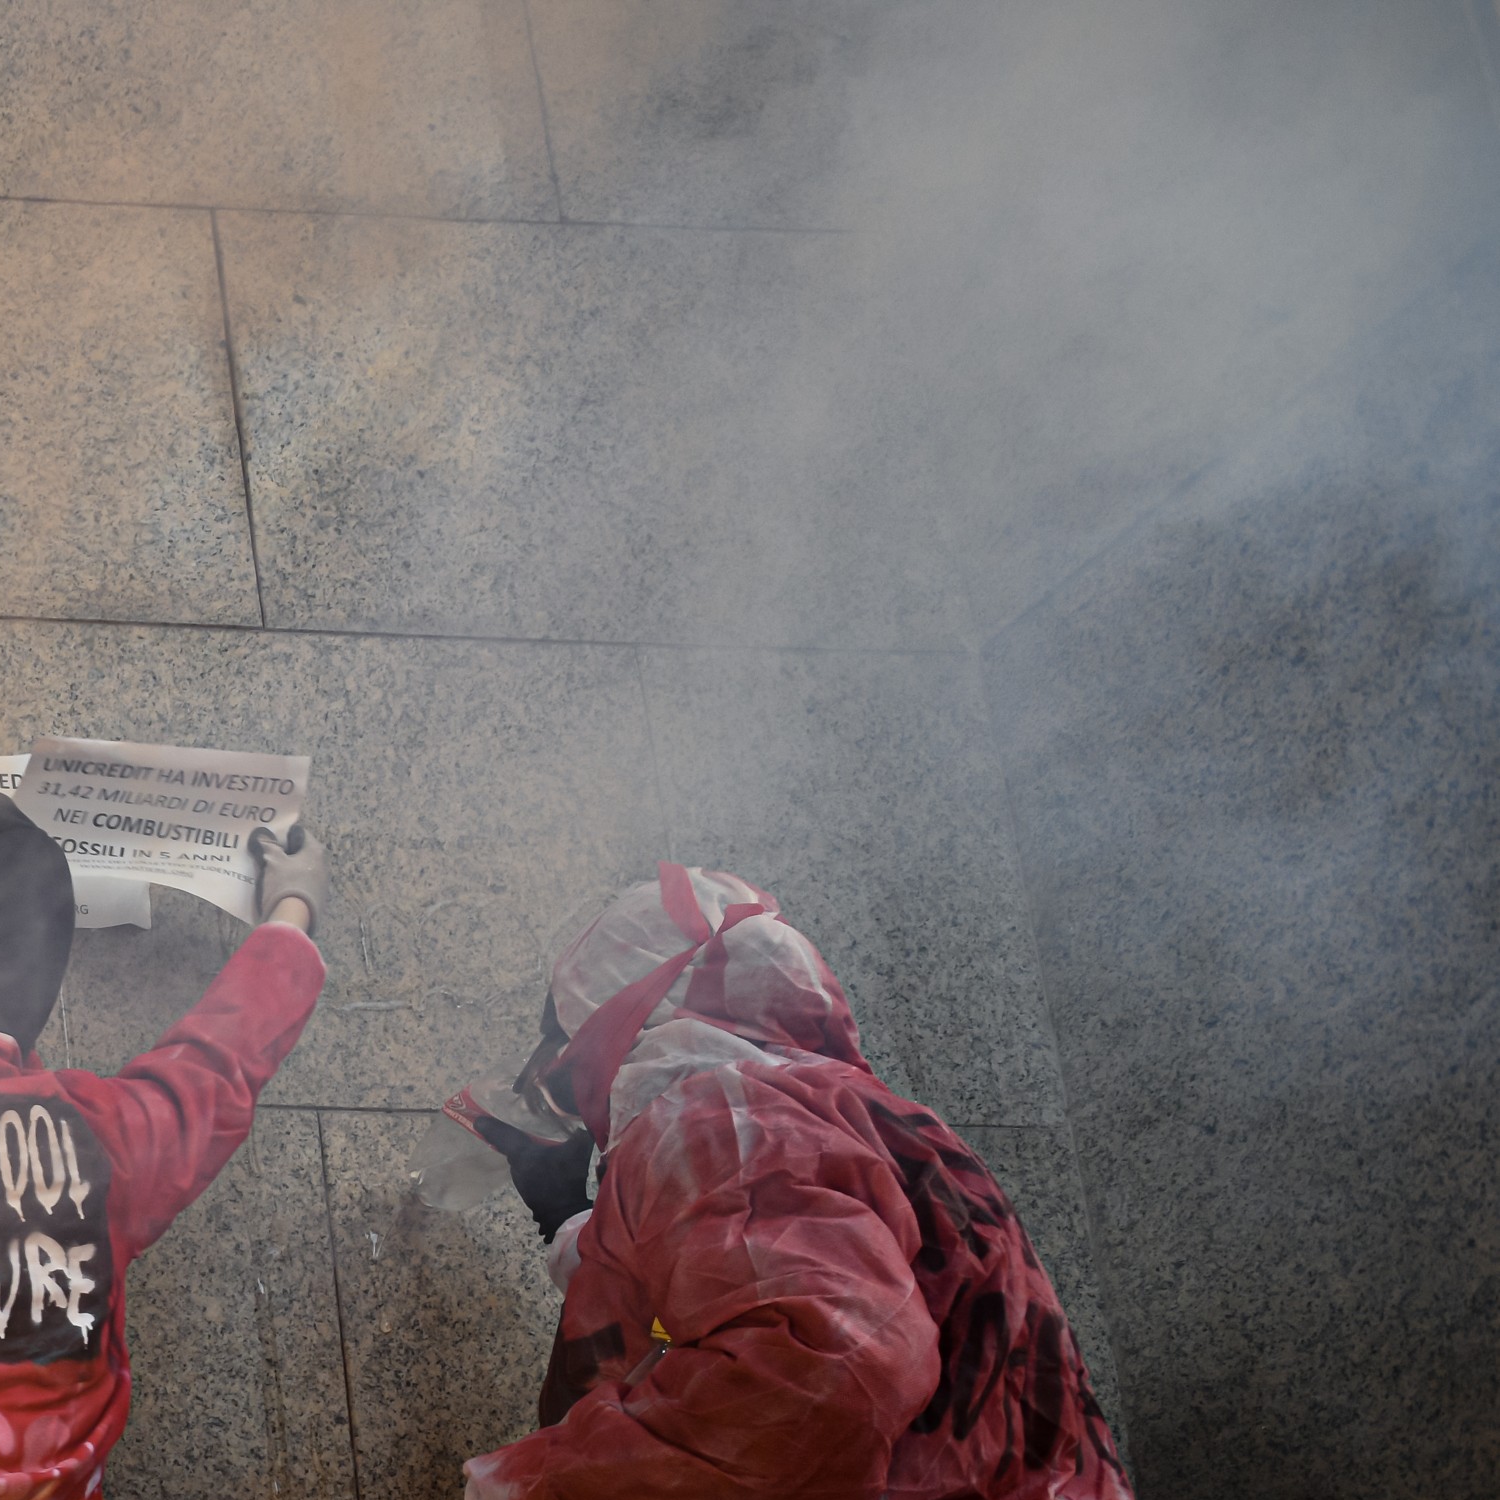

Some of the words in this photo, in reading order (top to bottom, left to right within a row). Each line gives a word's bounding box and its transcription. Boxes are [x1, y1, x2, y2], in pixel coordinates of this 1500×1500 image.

[43, 758, 154, 780] UNICREDIT
[156, 768, 185, 785] HA
[191, 771, 295, 795] INVESTITO
[37, 781, 93, 799] 31,42
[97, 788, 188, 810] MILIARDI
[192, 800, 214, 814] DI
[219, 803, 276, 823] EURO
[53, 808, 89, 824] NEI
[92, 813, 239, 849] COMBUSTIBILI
[53, 836, 125, 857] OSSILI
[178, 853, 231, 862] ANNI
